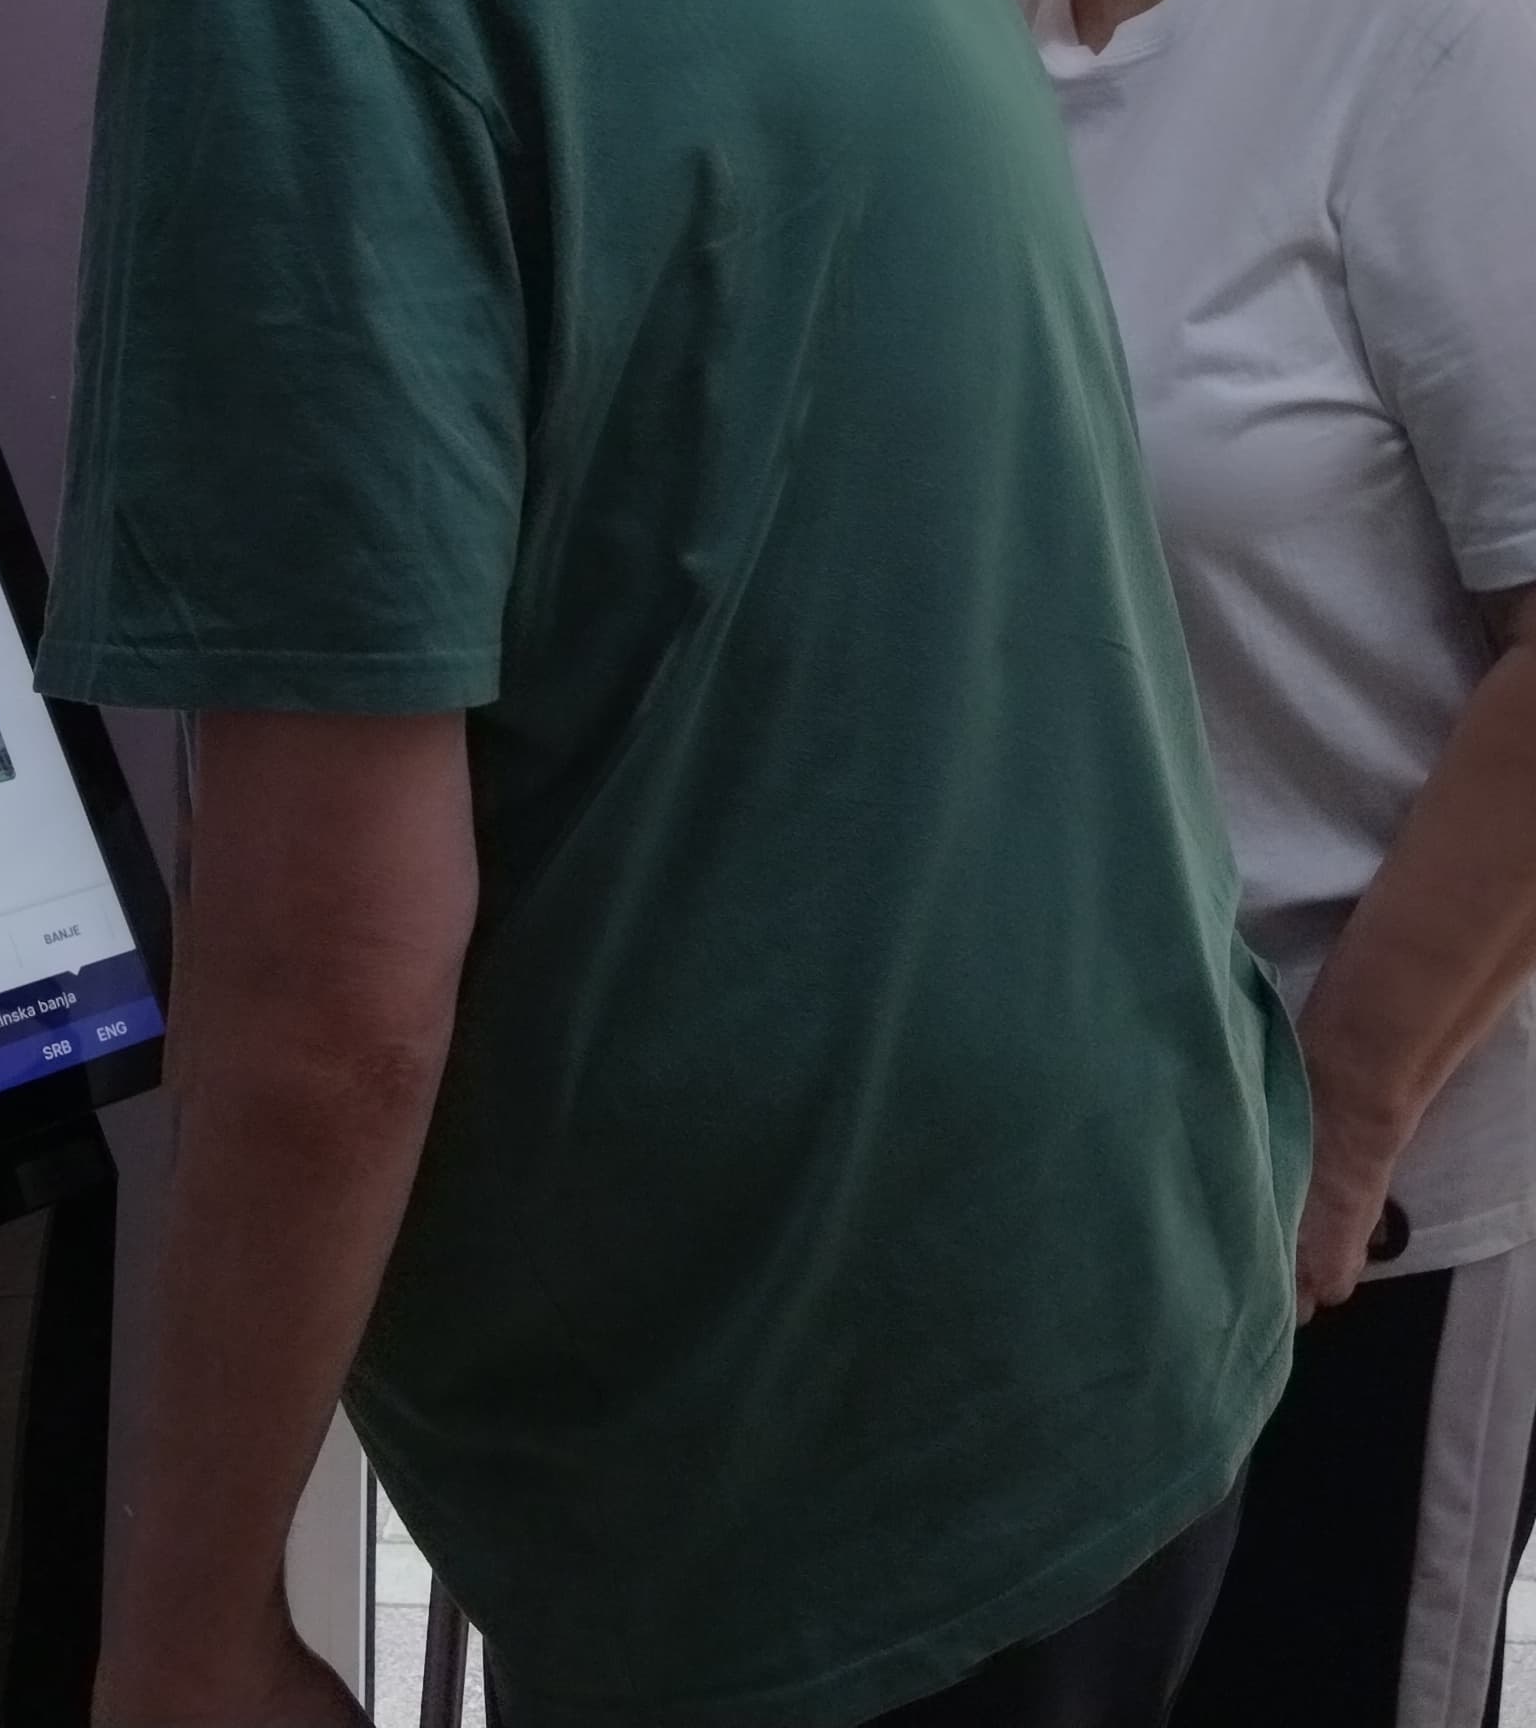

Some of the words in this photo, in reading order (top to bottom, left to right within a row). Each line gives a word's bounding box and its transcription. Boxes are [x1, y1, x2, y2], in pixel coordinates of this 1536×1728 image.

[42, 924, 81, 945] BANJE
[37, 989, 78, 1016] banja
[95, 1019, 129, 1042] ENG
[41, 1038, 73, 1061] SRB
